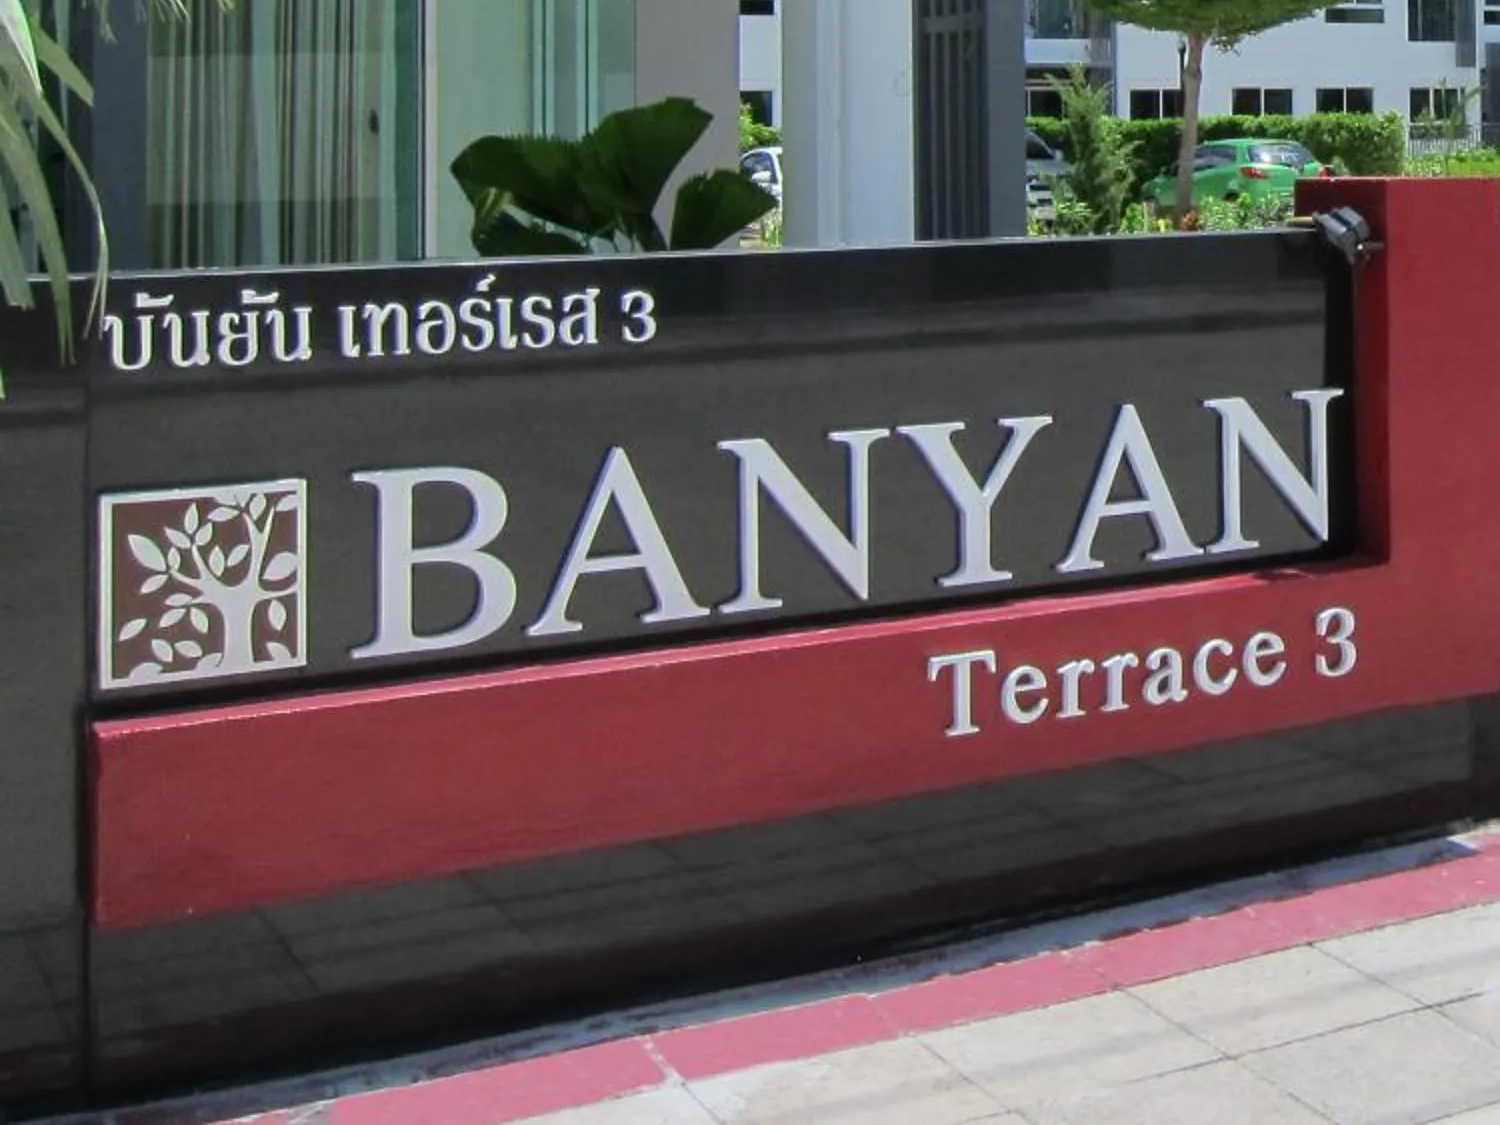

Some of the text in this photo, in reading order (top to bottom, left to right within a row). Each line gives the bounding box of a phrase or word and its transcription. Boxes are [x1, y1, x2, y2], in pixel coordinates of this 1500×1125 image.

[103, 273, 658, 371] บันยัน เทอร์เรส 3
[348, 388, 1345, 661] BANYAN
[927, 607, 1357, 737] Terrace 3
